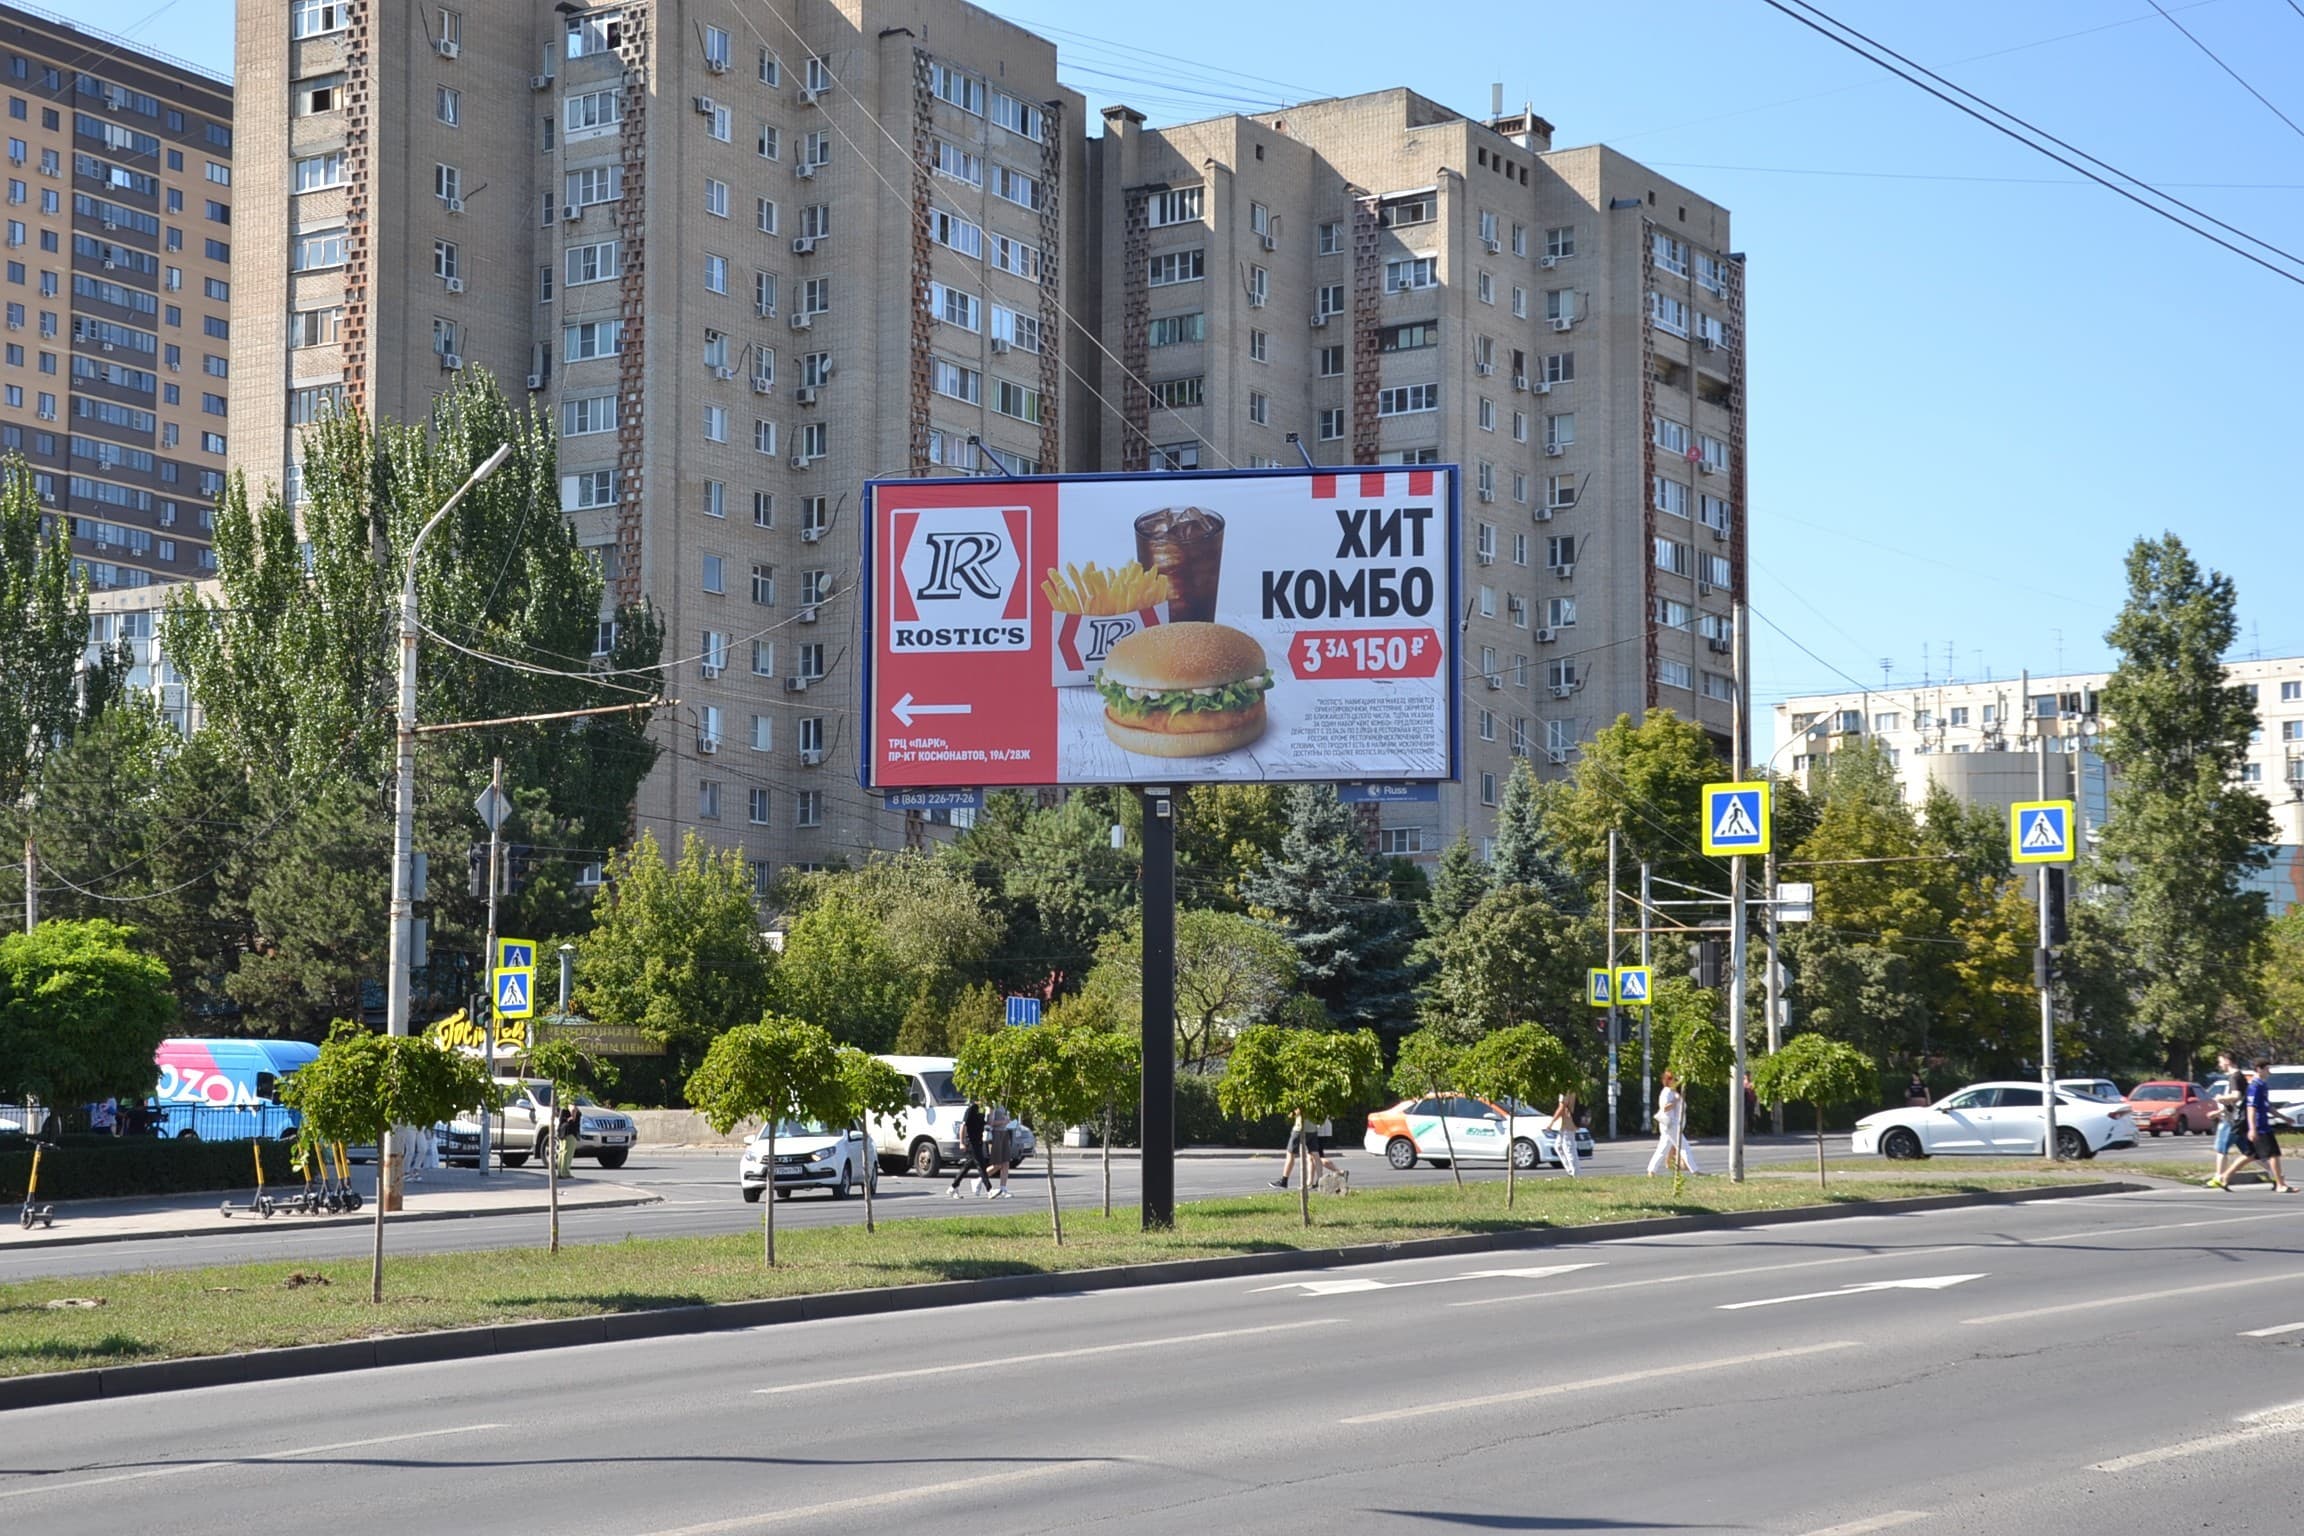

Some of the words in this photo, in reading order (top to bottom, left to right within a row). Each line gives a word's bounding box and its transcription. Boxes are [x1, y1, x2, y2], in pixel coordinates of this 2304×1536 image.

[1335, 507, 1433, 559] ХИТ
[917, 532, 1002, 600] R
[1262, 566, 1434, 620] КОМБО
[896, 627, 1025, 646] ROSTIC'S
[1302, 638, 1322, 673] 3
[1325, 638, 1350, 658] ЗА
[1353, 636, 1407, 671] 150
[888, 738, 907, 750] ТРЦ
[909, 738, 949, 750] «ПАРК»,
[888, 751, 915, 762] ПР-КТ
[918, 750, 988, 763] КОСМОНАВТОВ,
[990, 749, 1031, 762] 19А/28Ж
[892, 795, 899, 805] 8
[901, 794, 926, 806] (863)
[928, 793, 975, 804] 226-77-26
[1383, 786, 1408, 795] Russ
[156, 1063, 261, 1117] OZON
